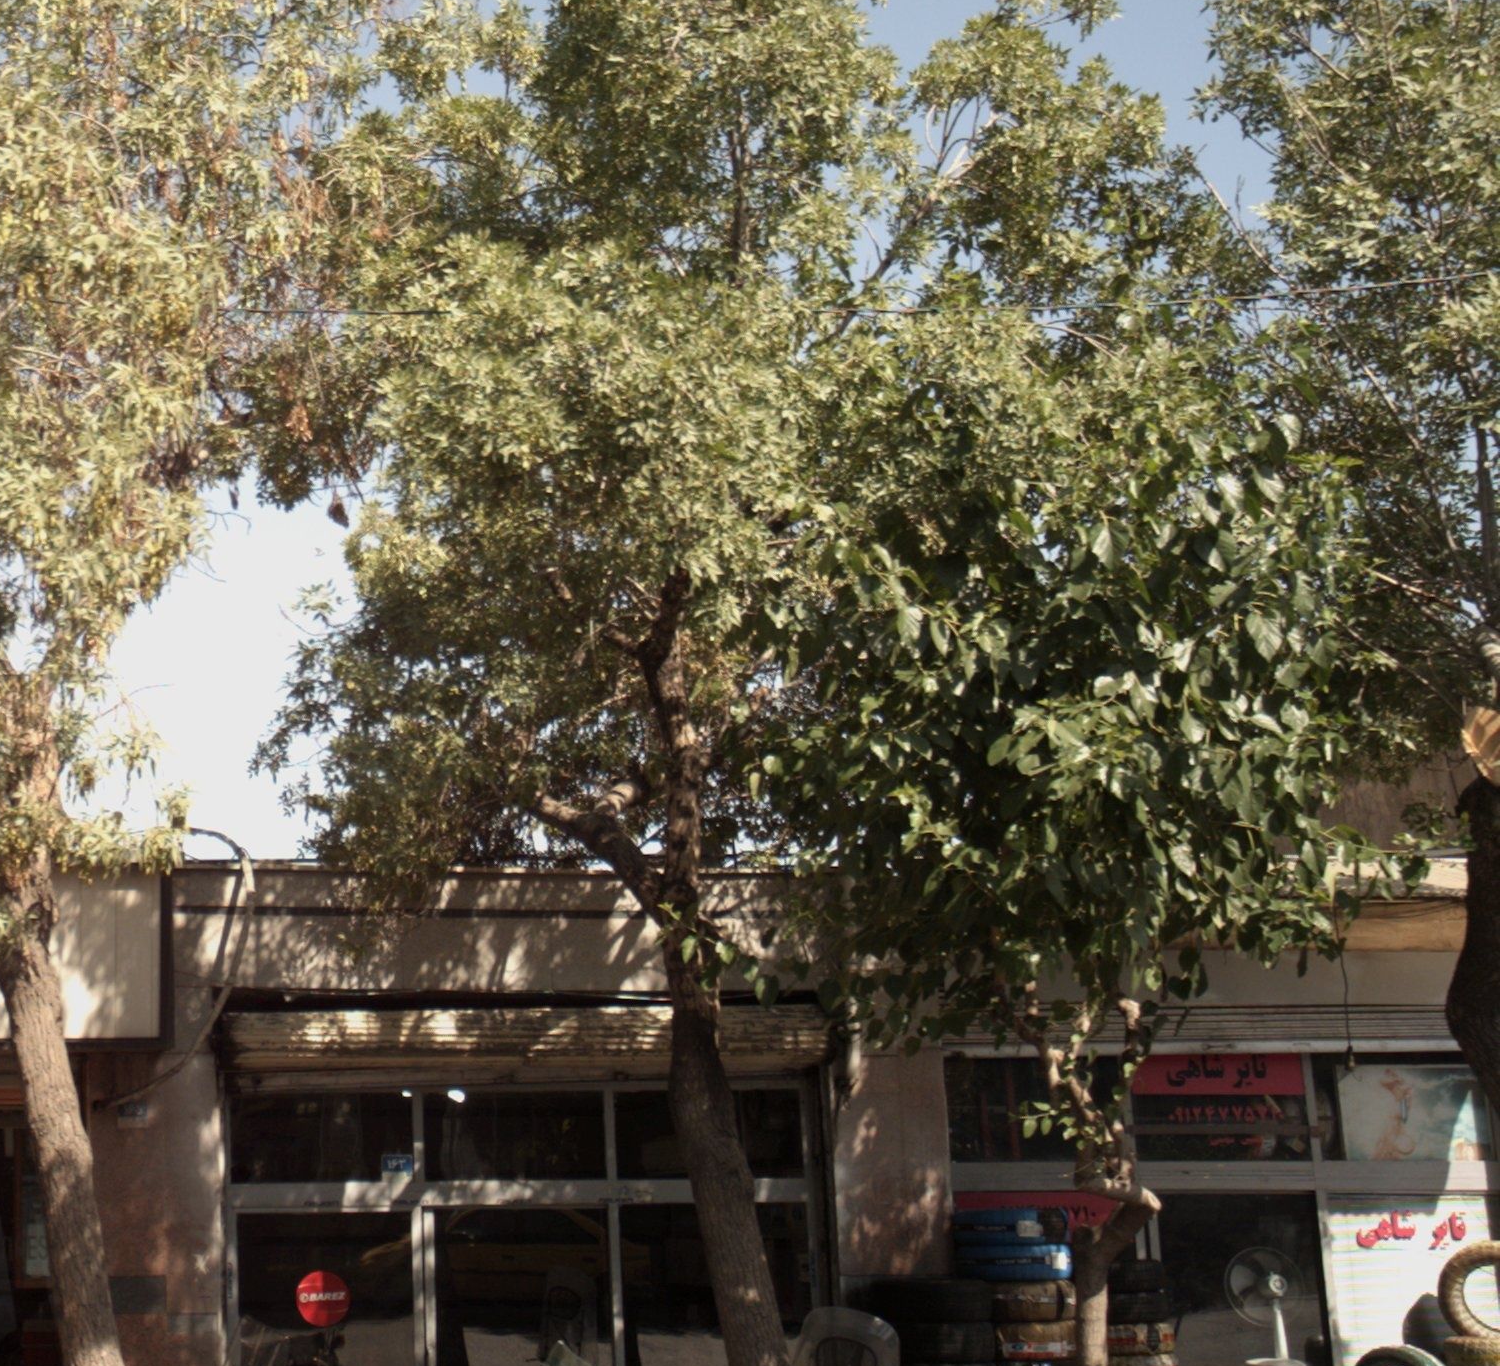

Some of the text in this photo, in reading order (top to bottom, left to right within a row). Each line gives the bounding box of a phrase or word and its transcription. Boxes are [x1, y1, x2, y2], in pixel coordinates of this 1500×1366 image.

[1356, 1209, 1467, 1250] تایر شاهی
[309, 1291, 346, 1302] BAREZ
